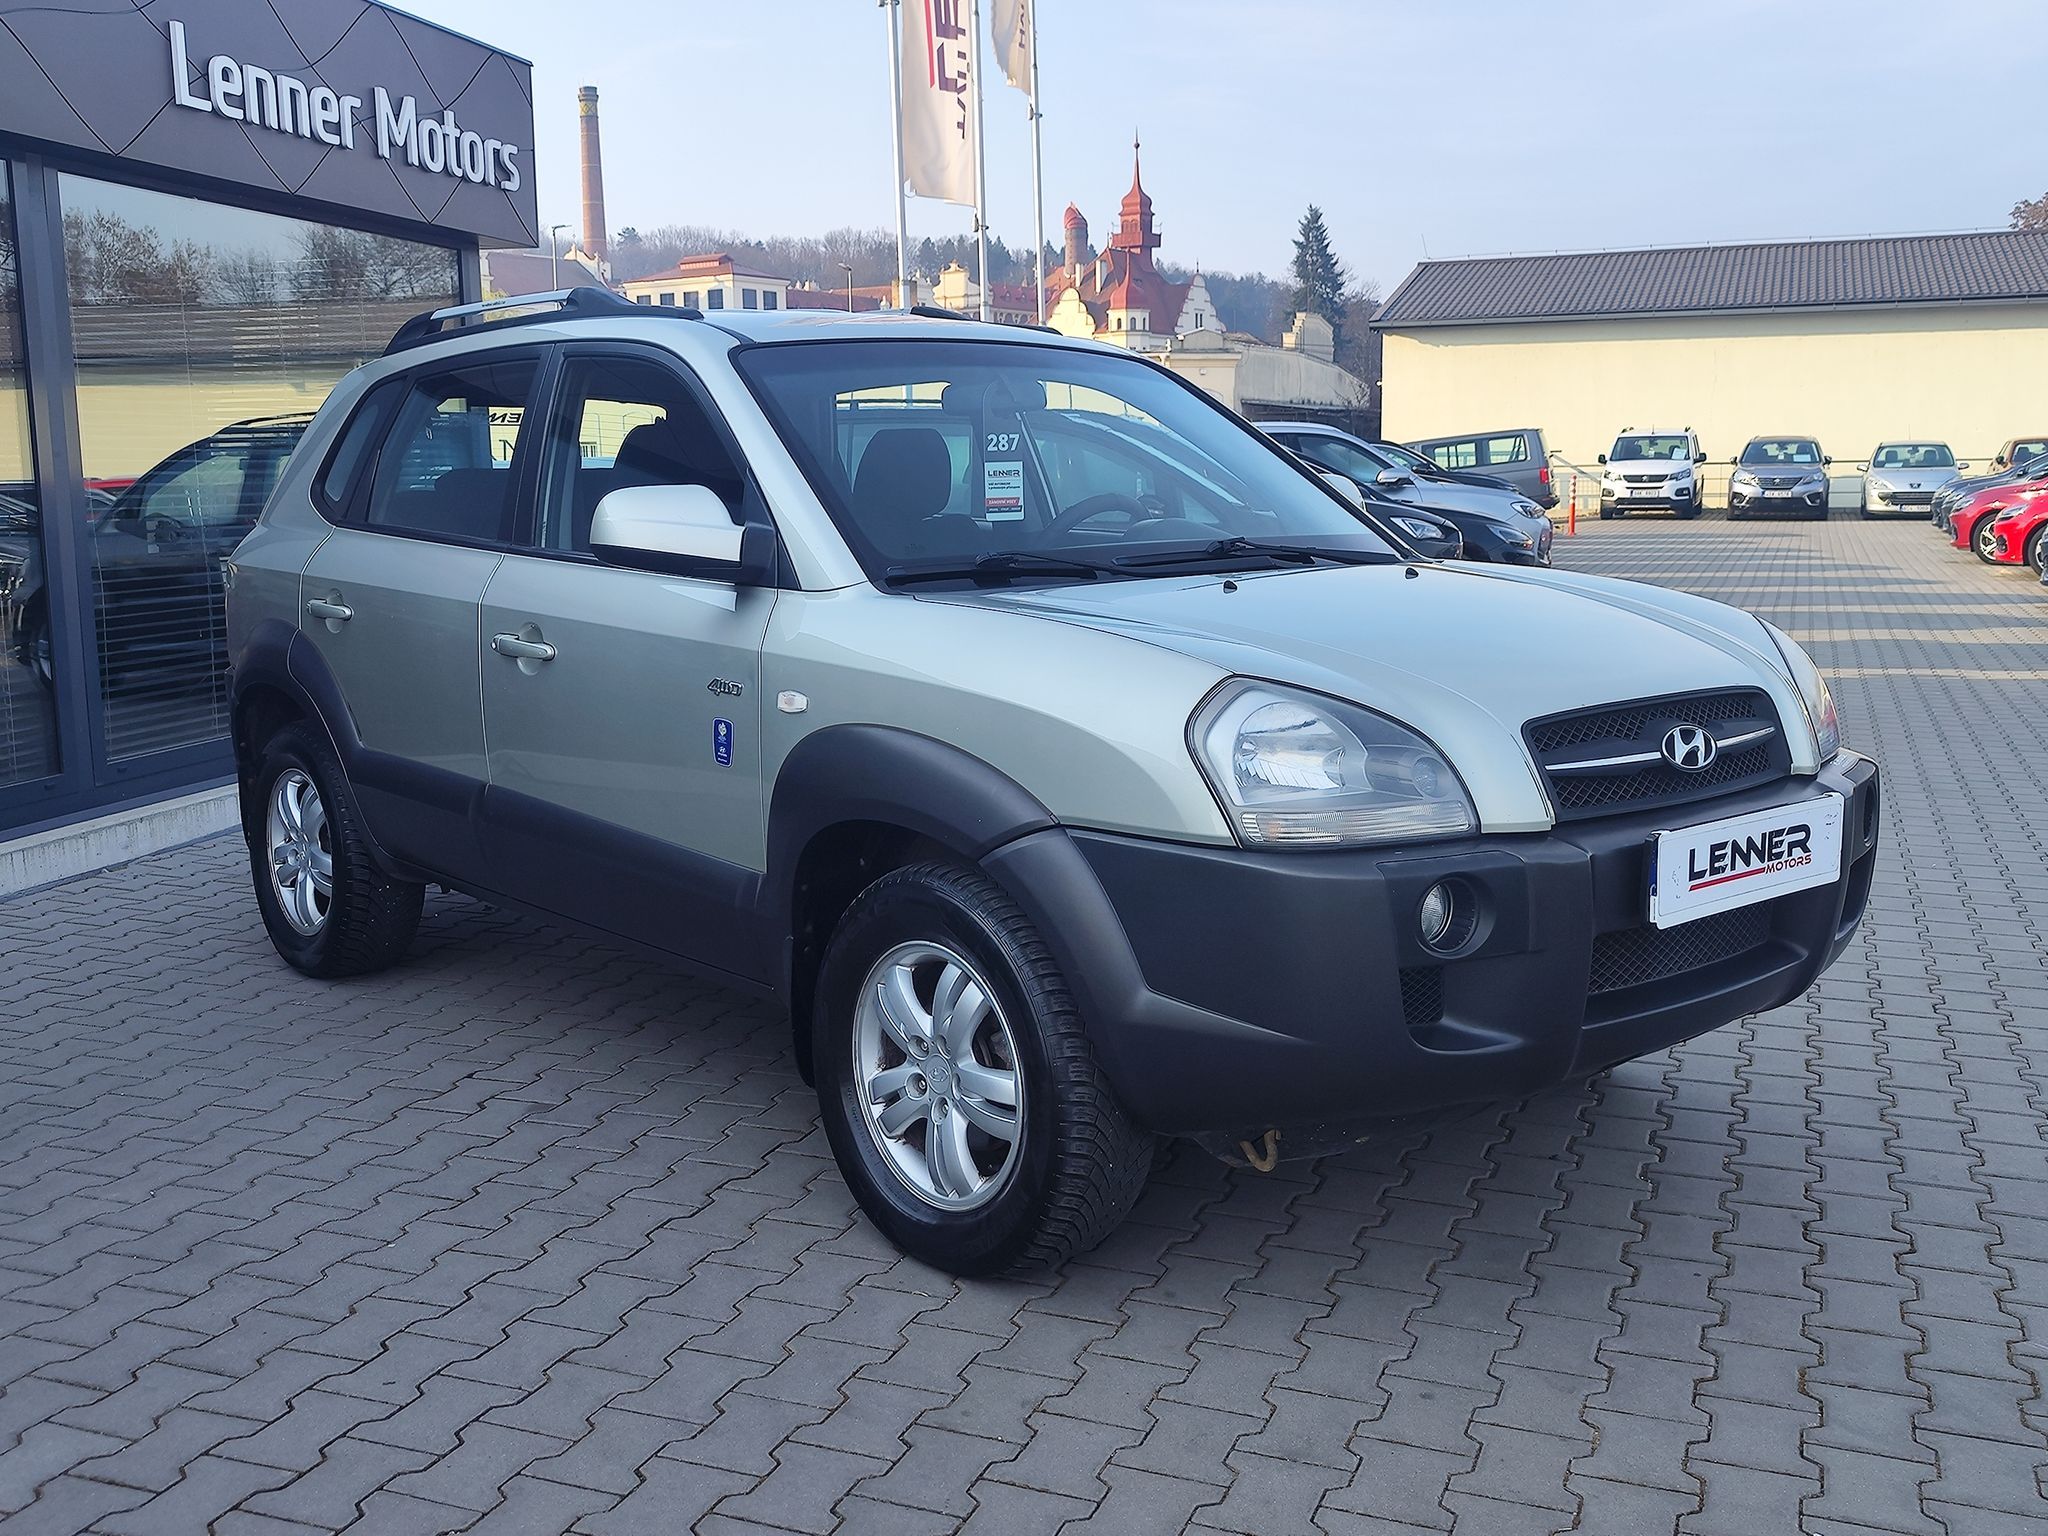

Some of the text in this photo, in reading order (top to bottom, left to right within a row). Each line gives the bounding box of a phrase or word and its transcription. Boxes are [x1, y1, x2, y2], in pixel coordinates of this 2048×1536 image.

[168, 20, 522, 192] Lenner Motors
[986, 433, 1020, 452] 287
[1688, 823, 1812, 883] LENNER
[1765, 853, 1812, 875] MOTORS
